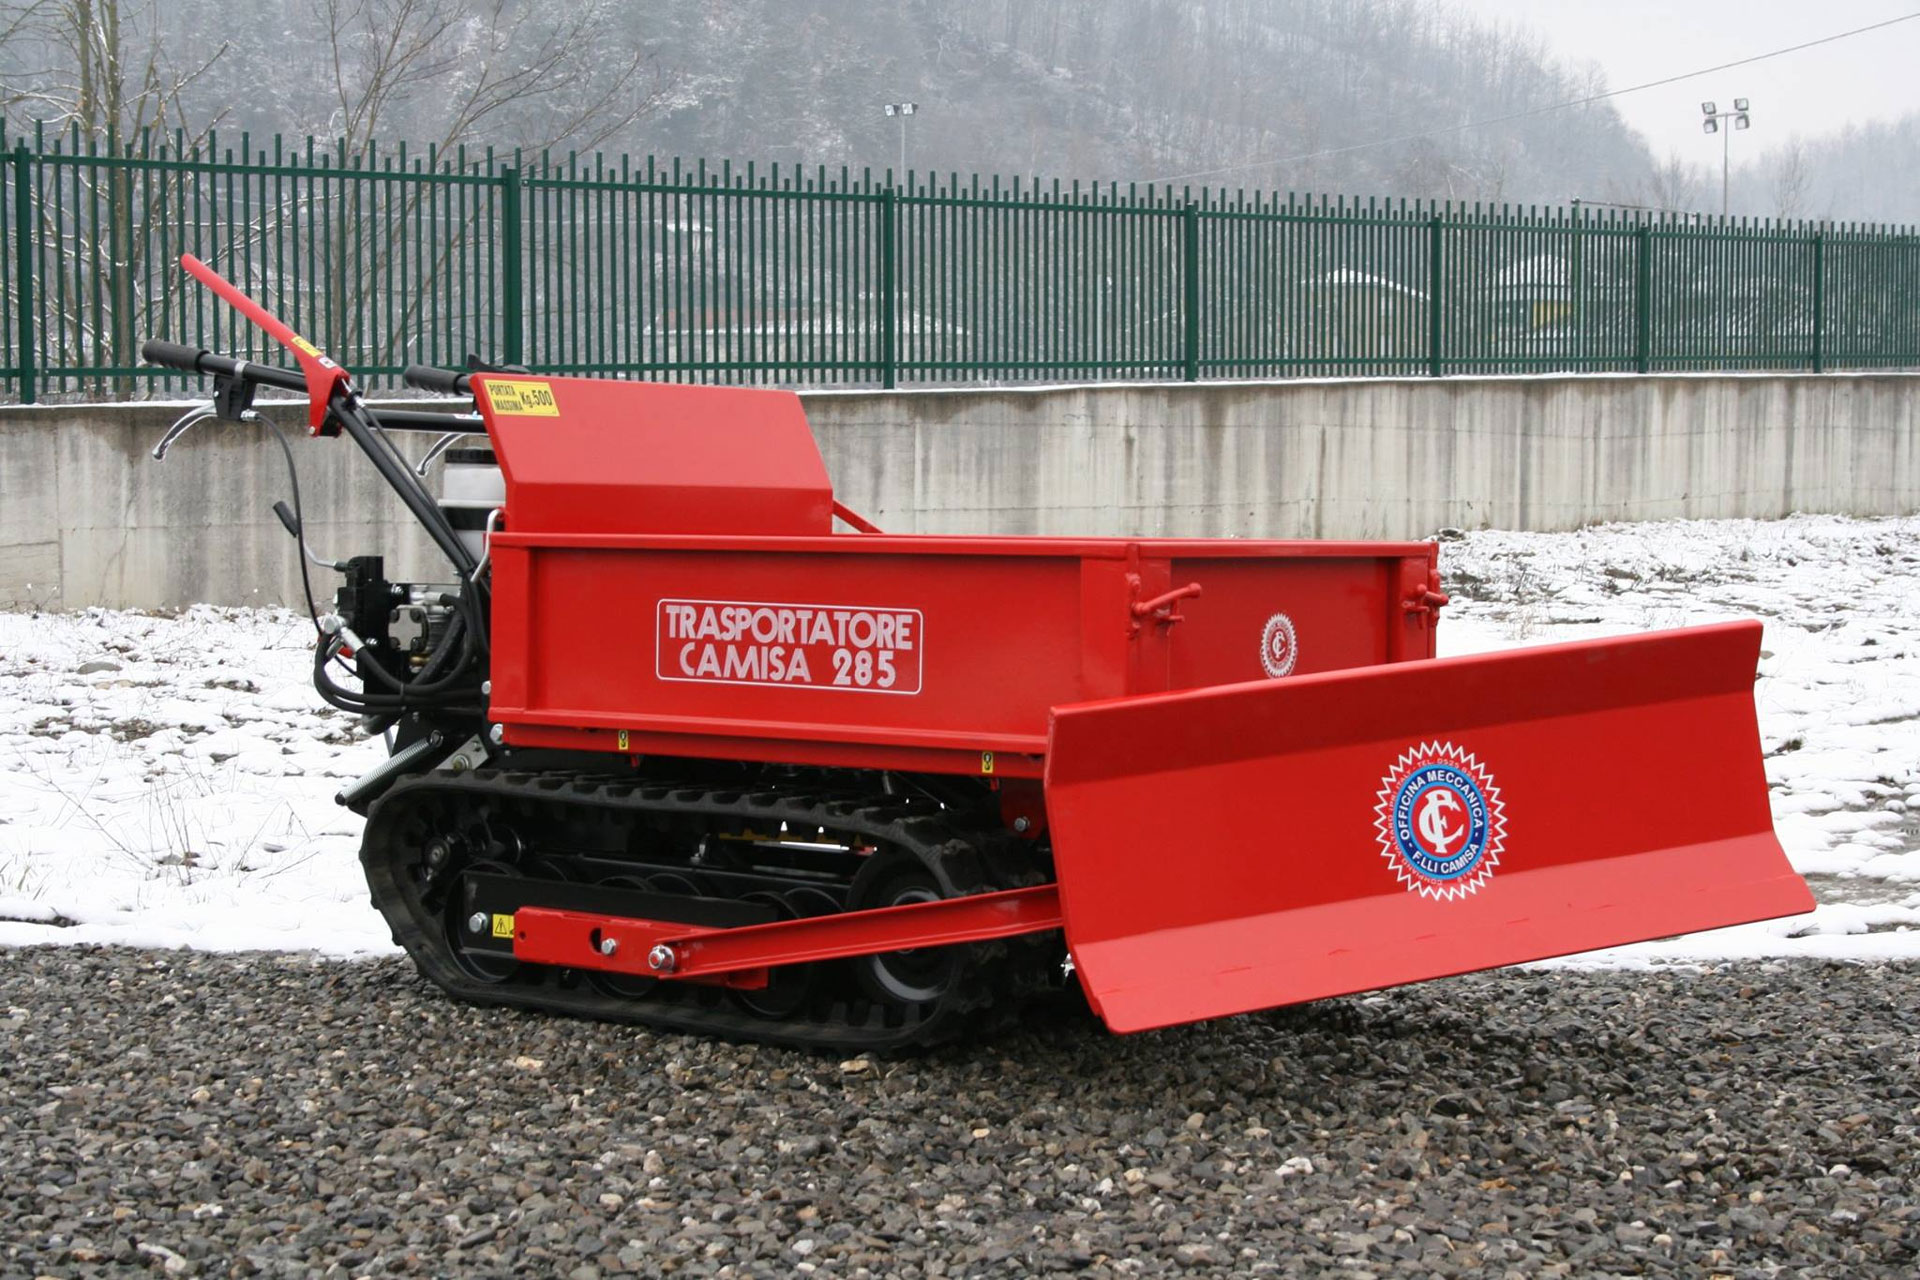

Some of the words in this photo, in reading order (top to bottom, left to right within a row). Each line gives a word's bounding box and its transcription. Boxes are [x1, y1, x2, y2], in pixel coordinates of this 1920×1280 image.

[665, 604, 913, 650] TRASPORTATORE
[679, 641, 812, 682] CAMISA
[832, 647, 896, 688] 285
[1398, 776, 1426, 840] OFFICINA
[1427, 770, 1484, 829] MECCANICA
[1412, 850, 1438, 873] F.LLI
[1440, 843, 1479, 874] CAMISA
